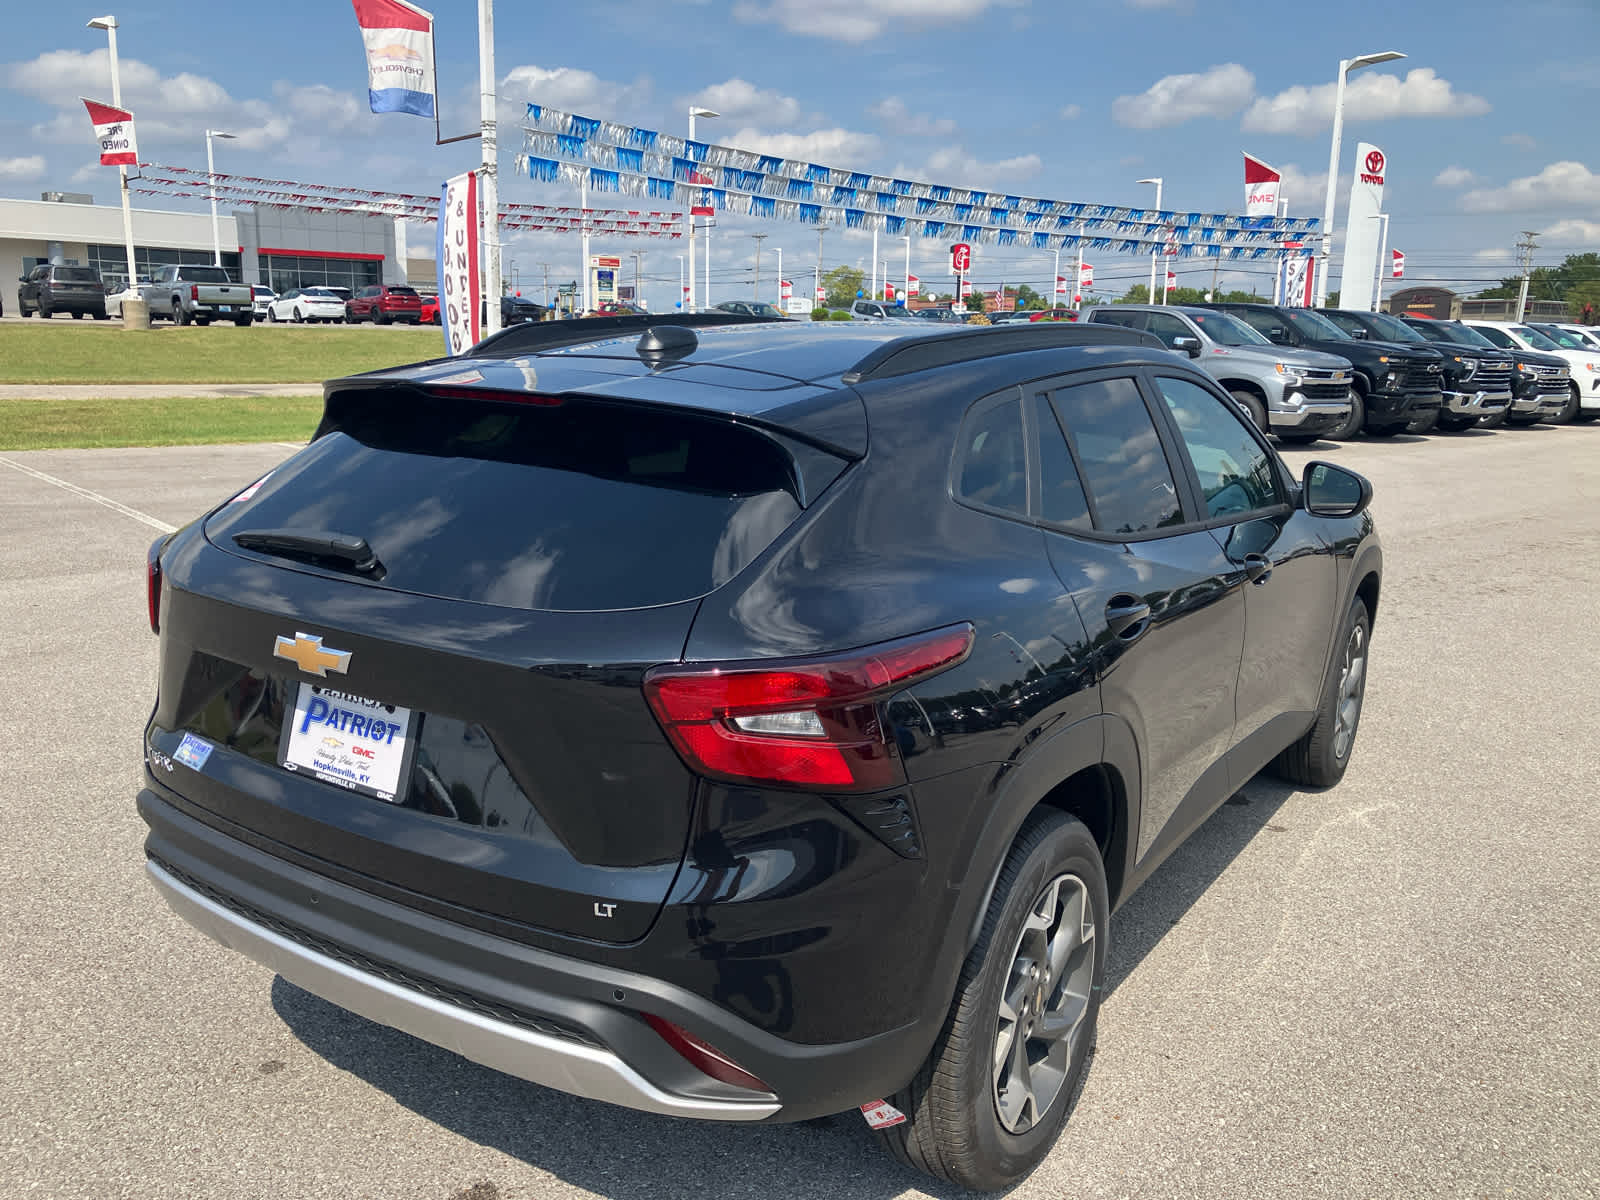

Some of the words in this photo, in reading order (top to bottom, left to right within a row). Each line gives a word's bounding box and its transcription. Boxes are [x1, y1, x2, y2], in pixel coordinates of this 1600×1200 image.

[1361, 173, 1384, 185] TOYOTA
[301, 696, 401, 745] PATRIOT
[352, 746, 375, 760] GMC
[359, 773, 371, 784] KY
[594, 902, 617, 918] LT
